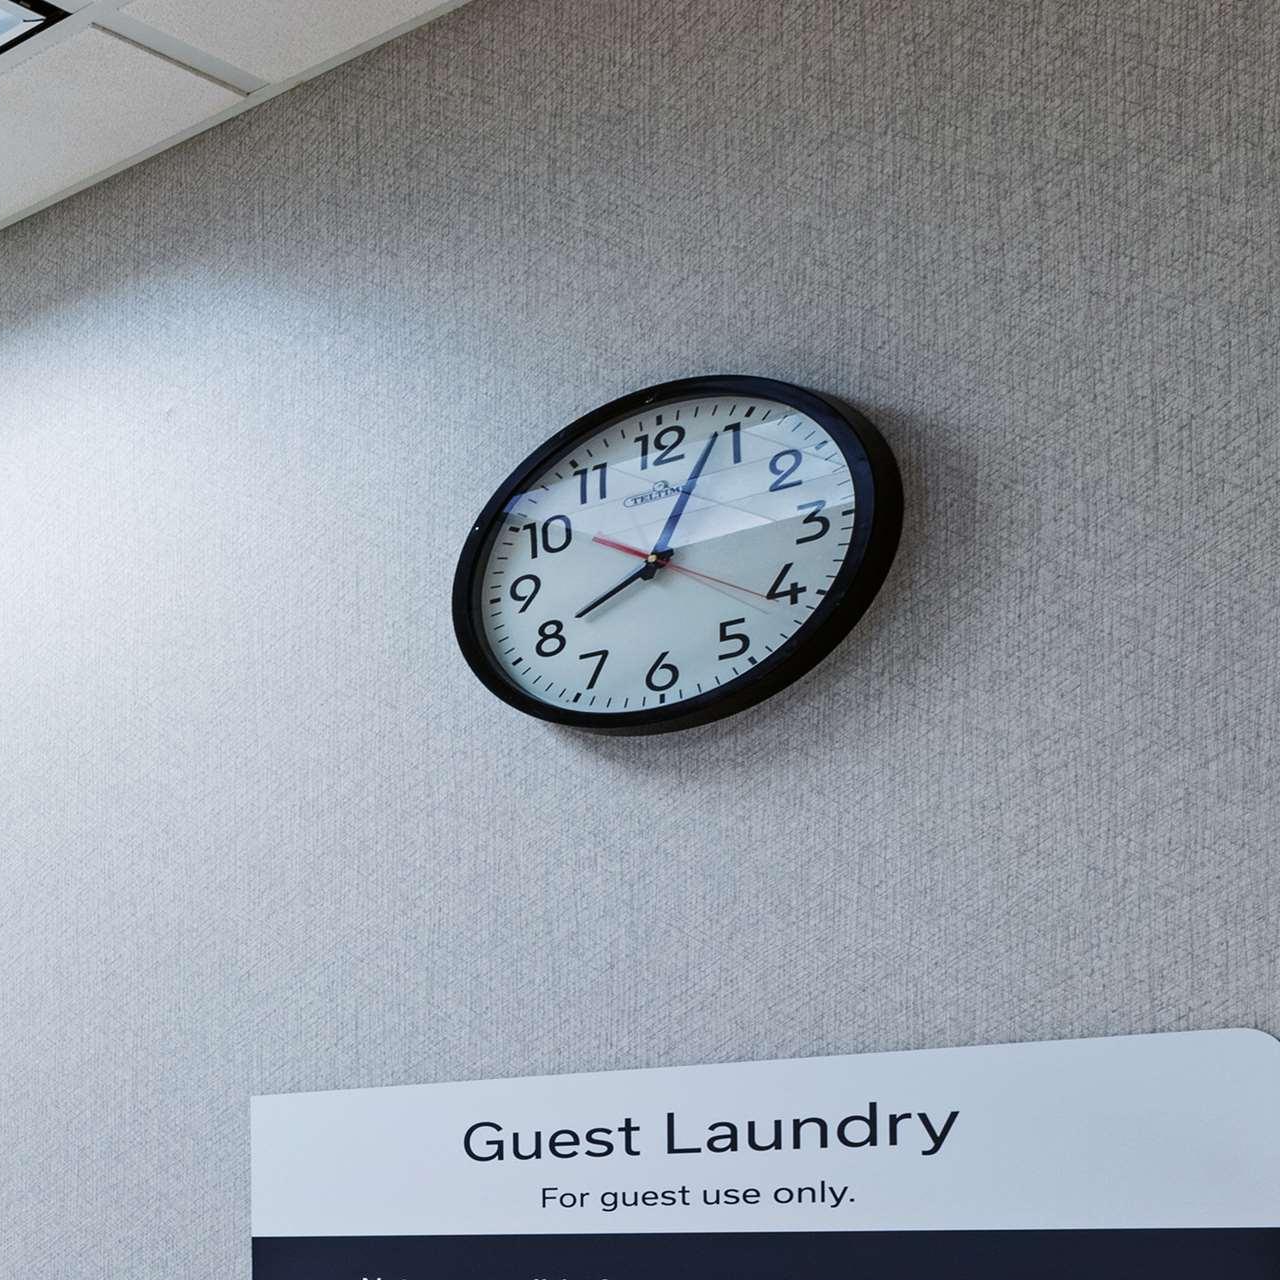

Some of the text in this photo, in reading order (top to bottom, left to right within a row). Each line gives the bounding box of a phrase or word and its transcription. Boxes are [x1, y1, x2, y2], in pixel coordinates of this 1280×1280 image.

[633, 424, 686, 471] 12
[724, 421, 743, 464] 1
[574, 463, 608, 504] 11
[767, 448, 804, 493] 2
[522, 513, 573, 560] 10
[795, 499, 830, 545] 3
[509, 573, 542, 614] 9
[765, 561, 808, 606] 4
[534, 619, 567, 658] 8
[717, 617, 751, 662] 5
[578, 648, 610, 691] 7
[644, 650, 680, 693] 6
[463, 1101, 961, 1162] Guest Laundry
[541, 1179, 855, 1213] For guest use only.
